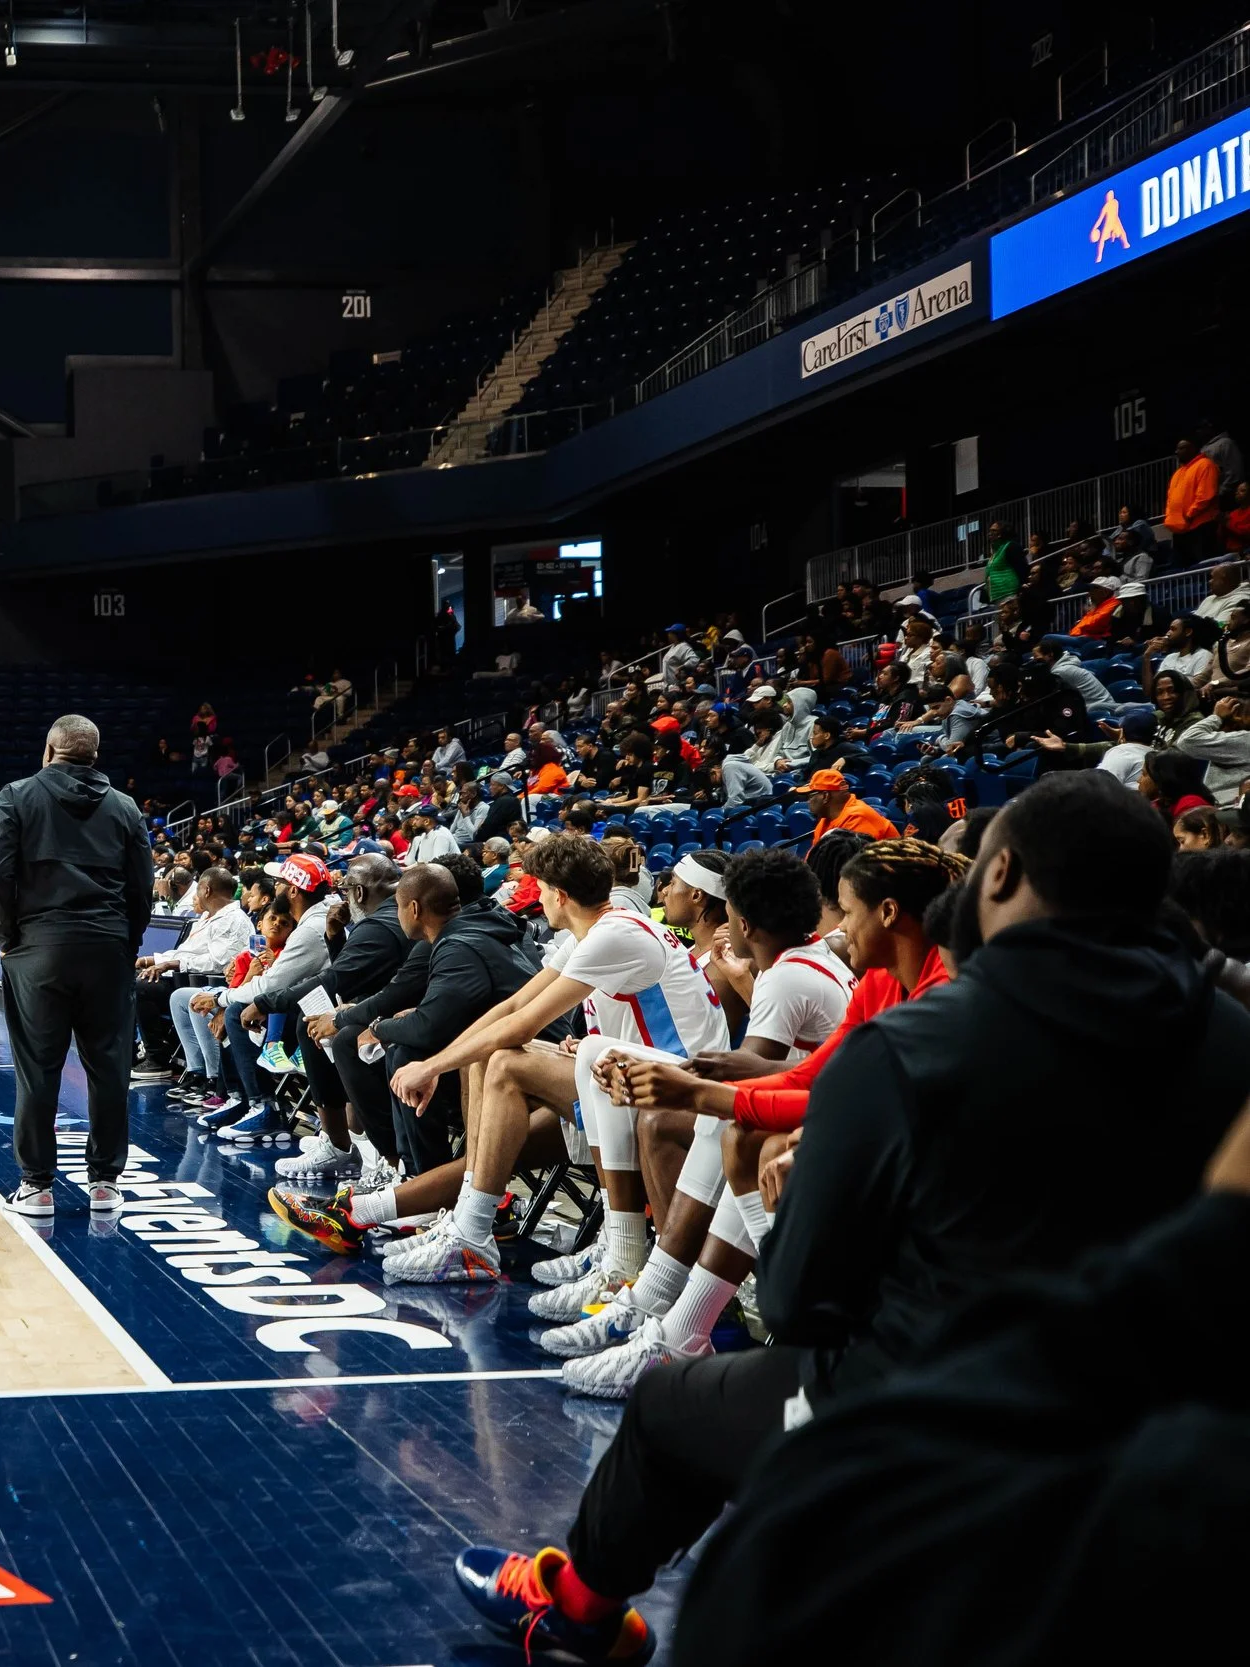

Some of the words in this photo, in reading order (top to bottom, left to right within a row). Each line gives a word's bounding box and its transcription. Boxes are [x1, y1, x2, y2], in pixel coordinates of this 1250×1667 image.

[1031, 32, 1053, 68] 202
[342, 295, 371, 318] 201
[803, 315, 872, 373] CareFirst
[911, 280, 971, 325] Arena
[1113, 396, 1147, 441] 105
[93, 593, 126, 616] 103
[281, 861, 311, 891] 1891
